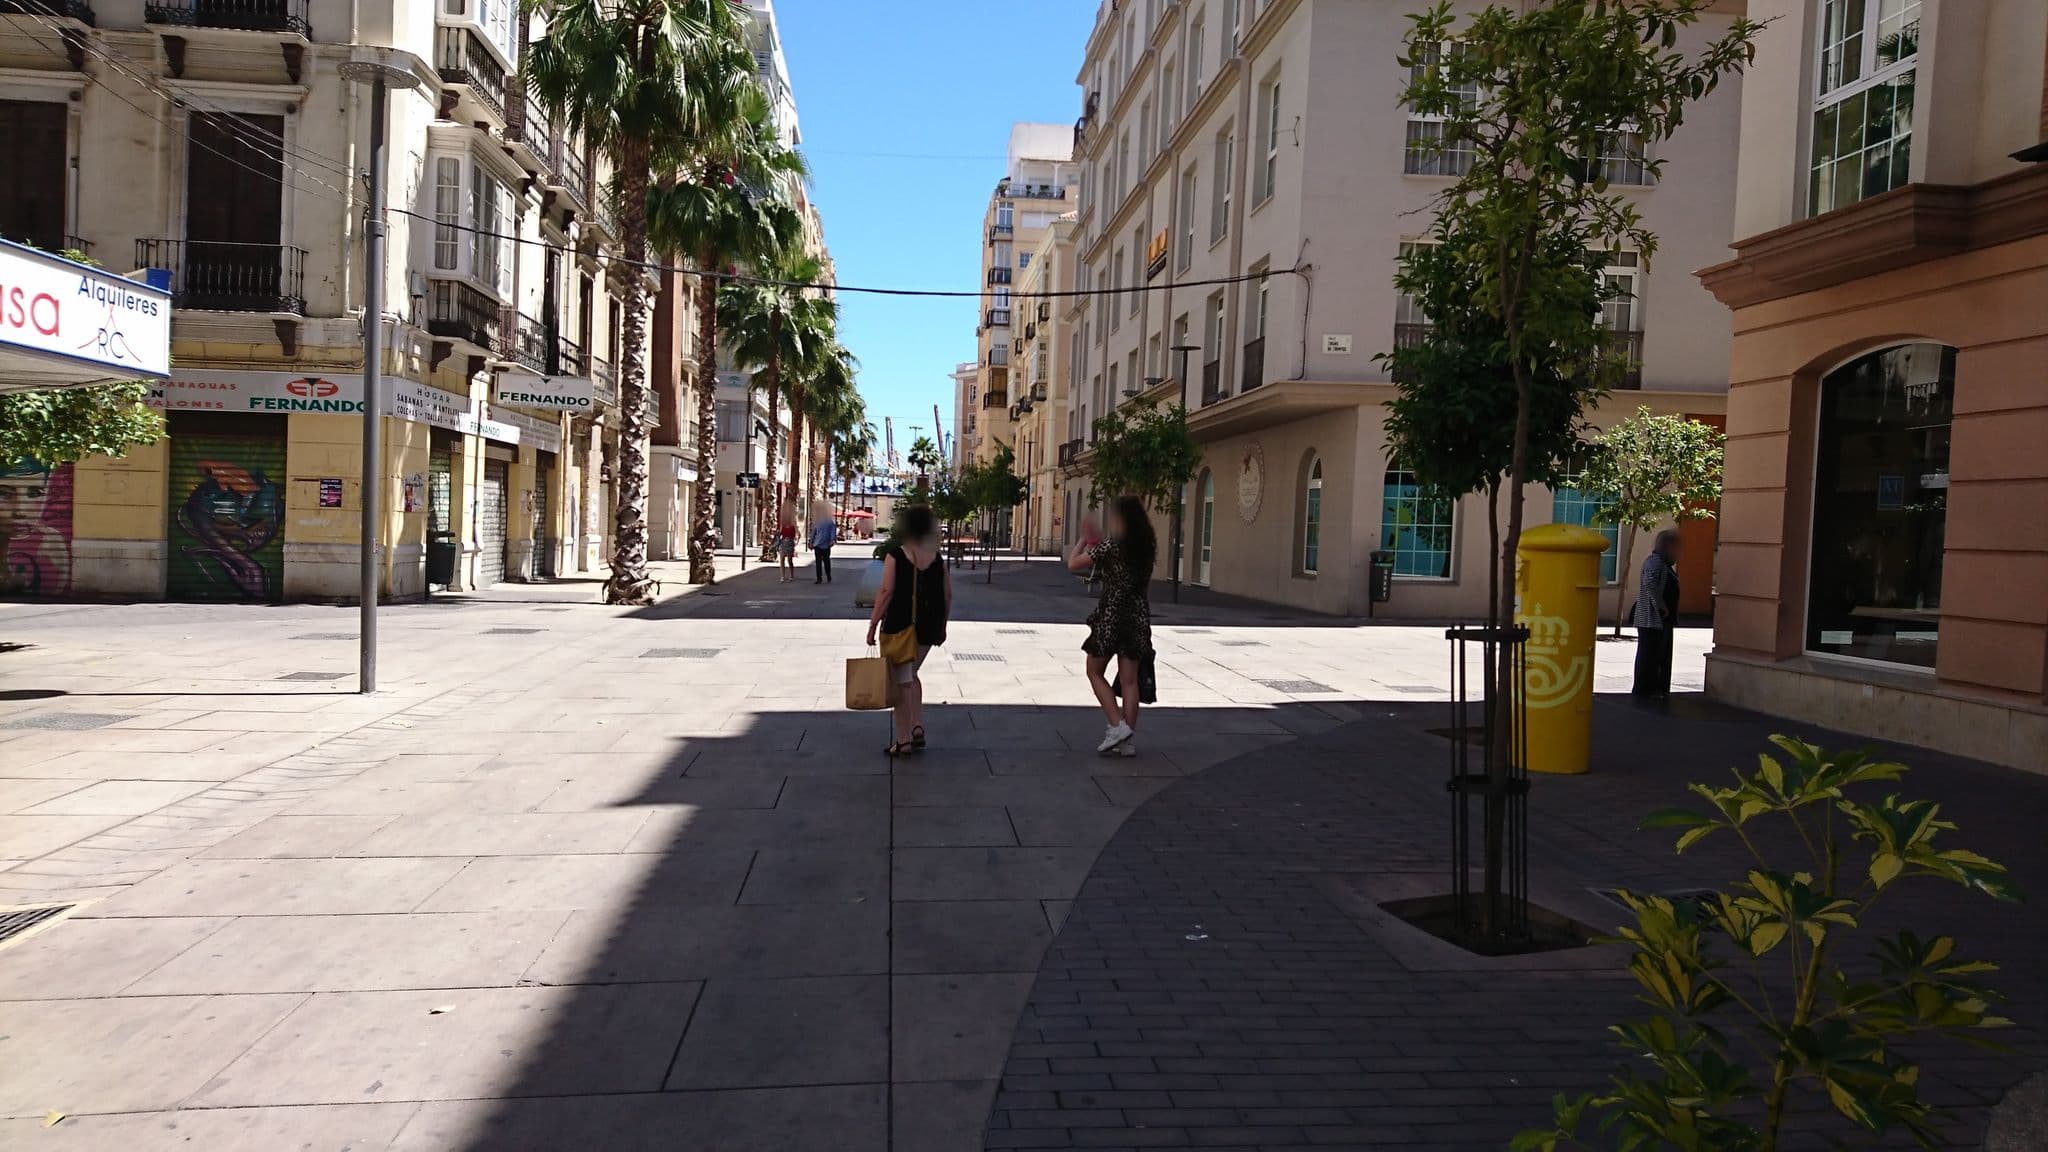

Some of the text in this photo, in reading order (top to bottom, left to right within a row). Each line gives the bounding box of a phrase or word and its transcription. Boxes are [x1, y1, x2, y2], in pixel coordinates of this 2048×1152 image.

[78, 275, 158, 317] Alquileres
[0, 284, 59, 337] sa
[97, 328, 125, 359] RC
[159, 380, 237, 391] PARAGUAS
[416, 387, 451, 404] HOGAR
[499, 391, 590, 407] FERNANDO
[470, 421, 501, 437] FENANDO
